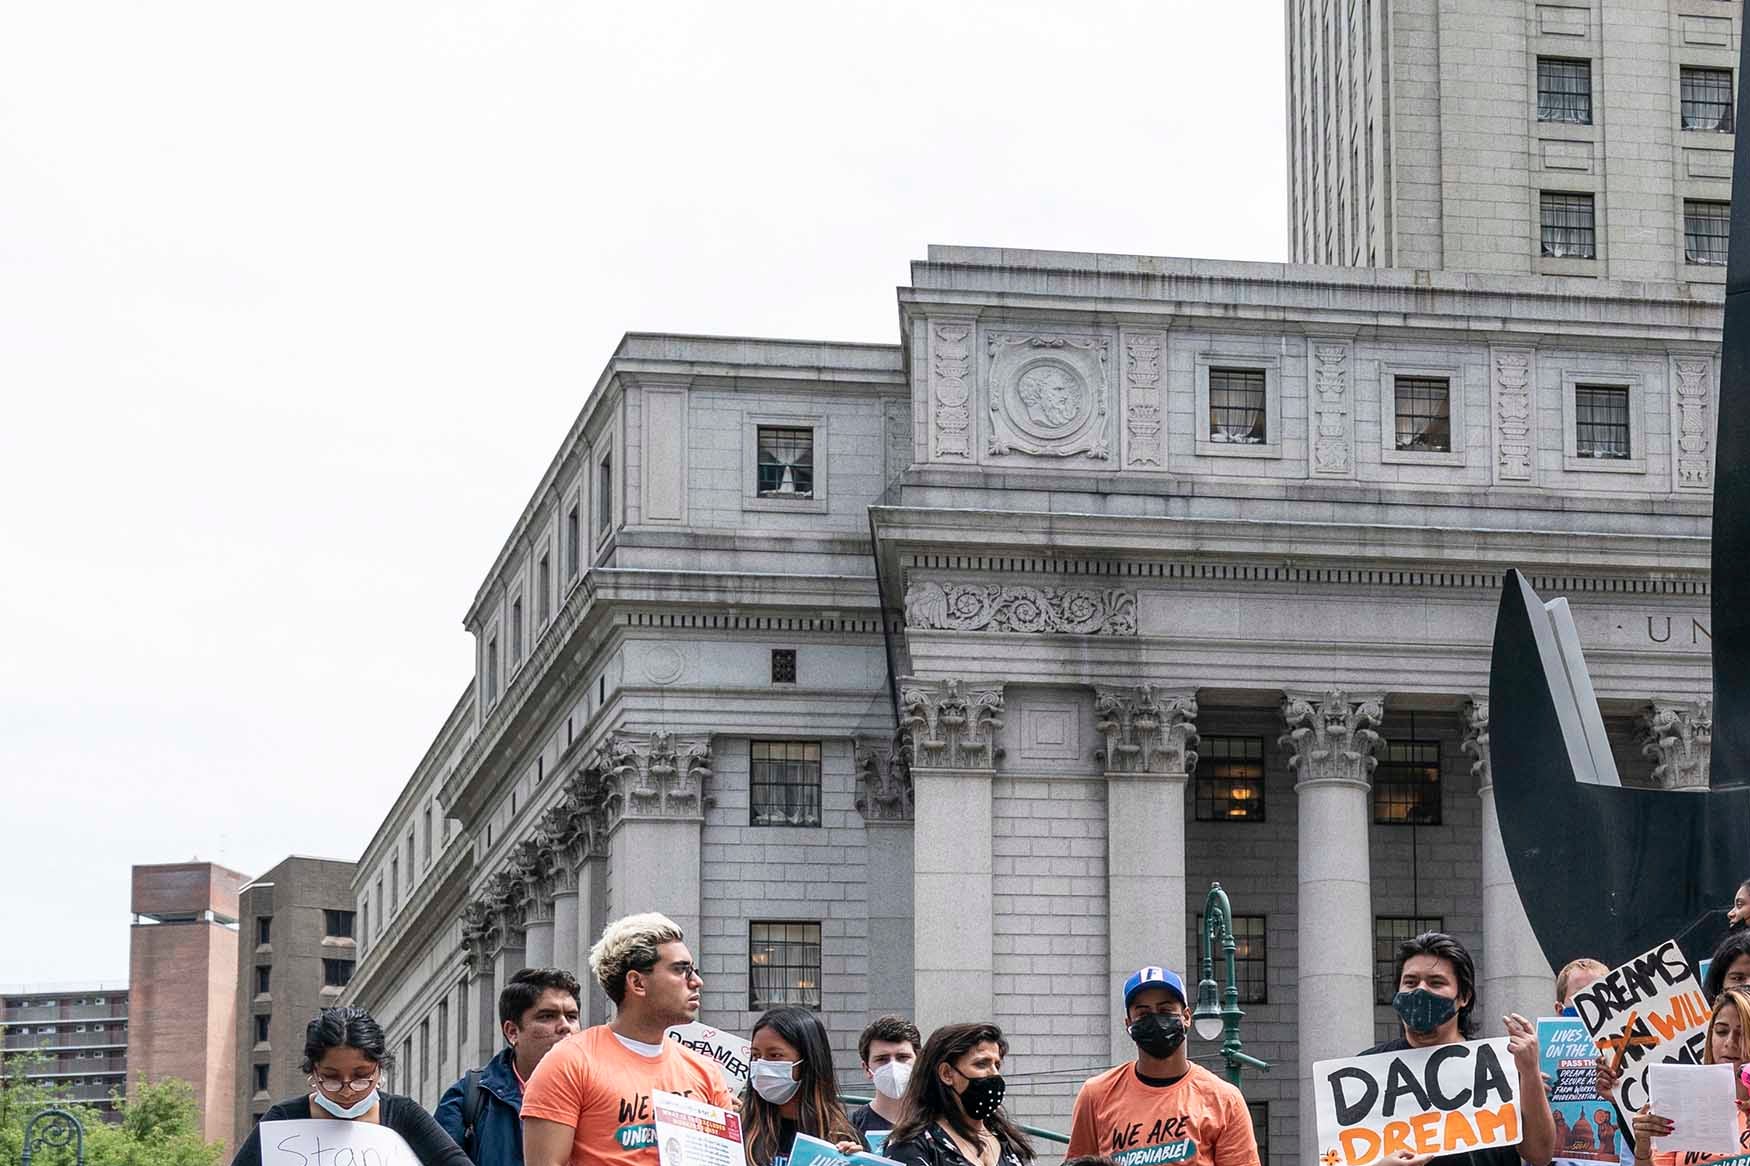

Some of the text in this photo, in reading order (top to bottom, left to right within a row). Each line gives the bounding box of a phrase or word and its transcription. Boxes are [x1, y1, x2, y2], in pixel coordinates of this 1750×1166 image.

[1573, 942, 1692, 1038] DREAMS
[1647, 990, 1714, 1041] WILL
[1546, 1044, 1565, 1058] ON
[1565, 1044, 1587, 1057] THE
[1552, 1028, 1582, 1043] LIVES
[1327, 1044, 1513, 1127] DACA
[1559, 1068, 1597, 1078] DREAM AC
[1559, 1077, 1597, 1086] SECURE AC
[618, 1093, 649, 1123] WE
[1112, 1115, 1190, 1150] WE ARE
[1338, 1103, 1518, 1166] DREAM
